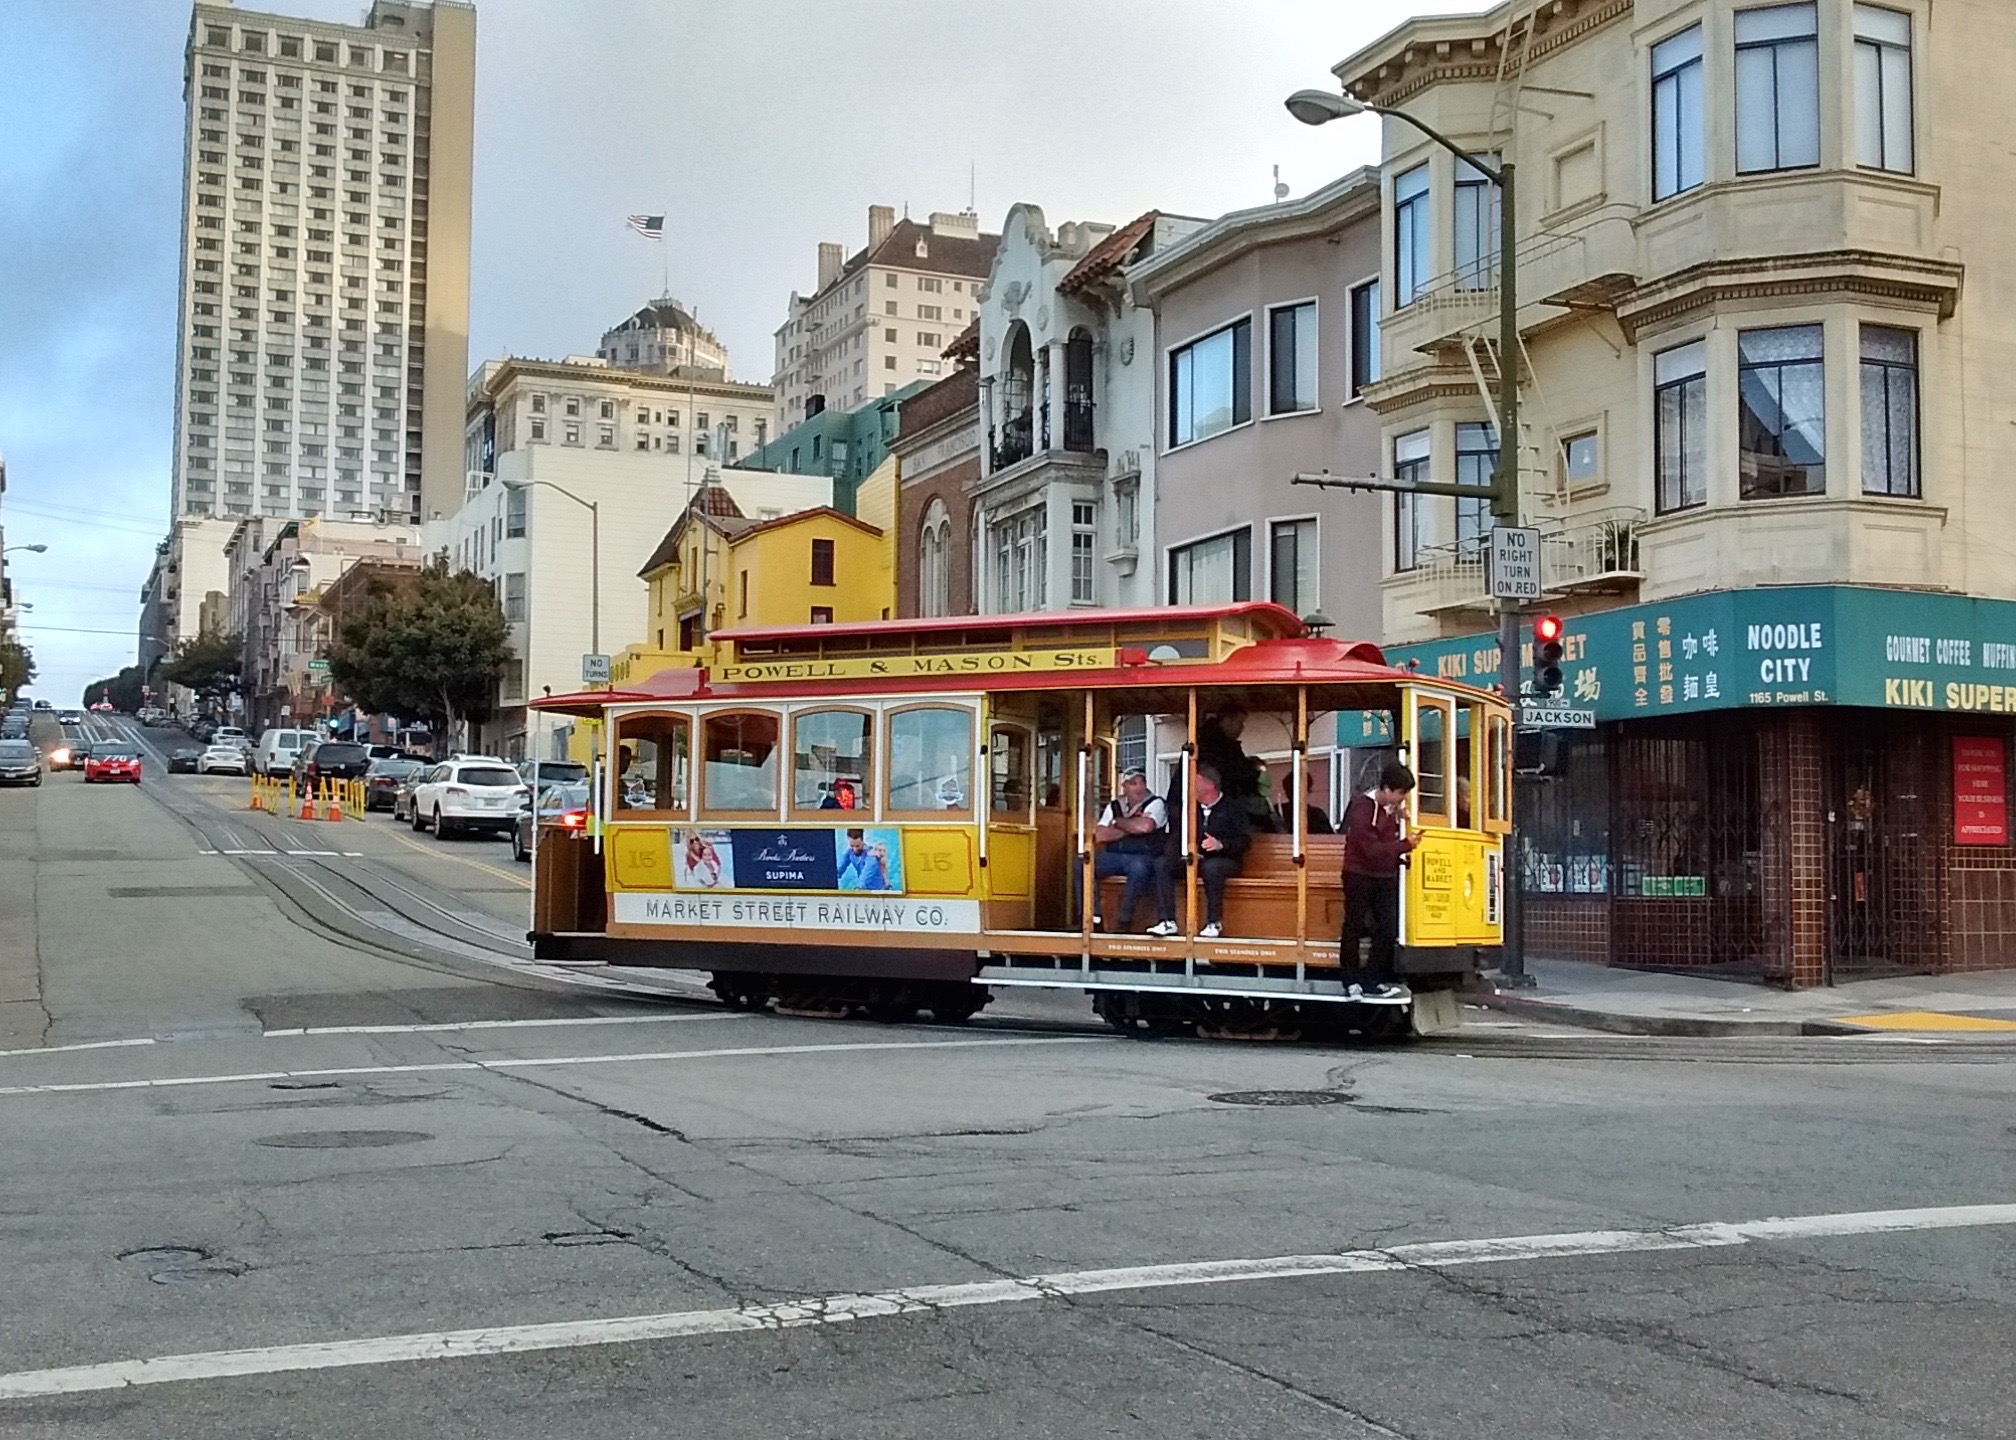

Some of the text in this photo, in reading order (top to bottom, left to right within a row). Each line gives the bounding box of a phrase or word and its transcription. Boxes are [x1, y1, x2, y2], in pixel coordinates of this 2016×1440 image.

[1507, 532, 1526, 547] NO
[1500, 549, 1533, 562] RIGHT
[1503, 565, 1531, 578] TURN
[1497, 581, 1537, 595] ON RED
[1747, 623, 1822, 650] NOODLE
[1886, 635, 1931, 664] GOURMET
[1936, 638, 1971, 666] COFFEE
[590, 659, 603, 667] NO
[722, 652, 1102, 680] POWELL & MASON Sts.
[1438, 654, 1467, 678] KIKI
[1760, 657, 1811, 683] CITY
[585, 670, 608, 678] TURNS
[1749, 690, 1829, 704] 1165 Powell St.
[1885, 678, 2016, 712] KIKI SUPER
[1526, 711, 1592, 724] JACKSON
[920, 852, 953, 871] 15
[765, 870, 804, 880] SUPIMA
[646, 900, 948, 926] MARKET STREET RAILWAY CO.
